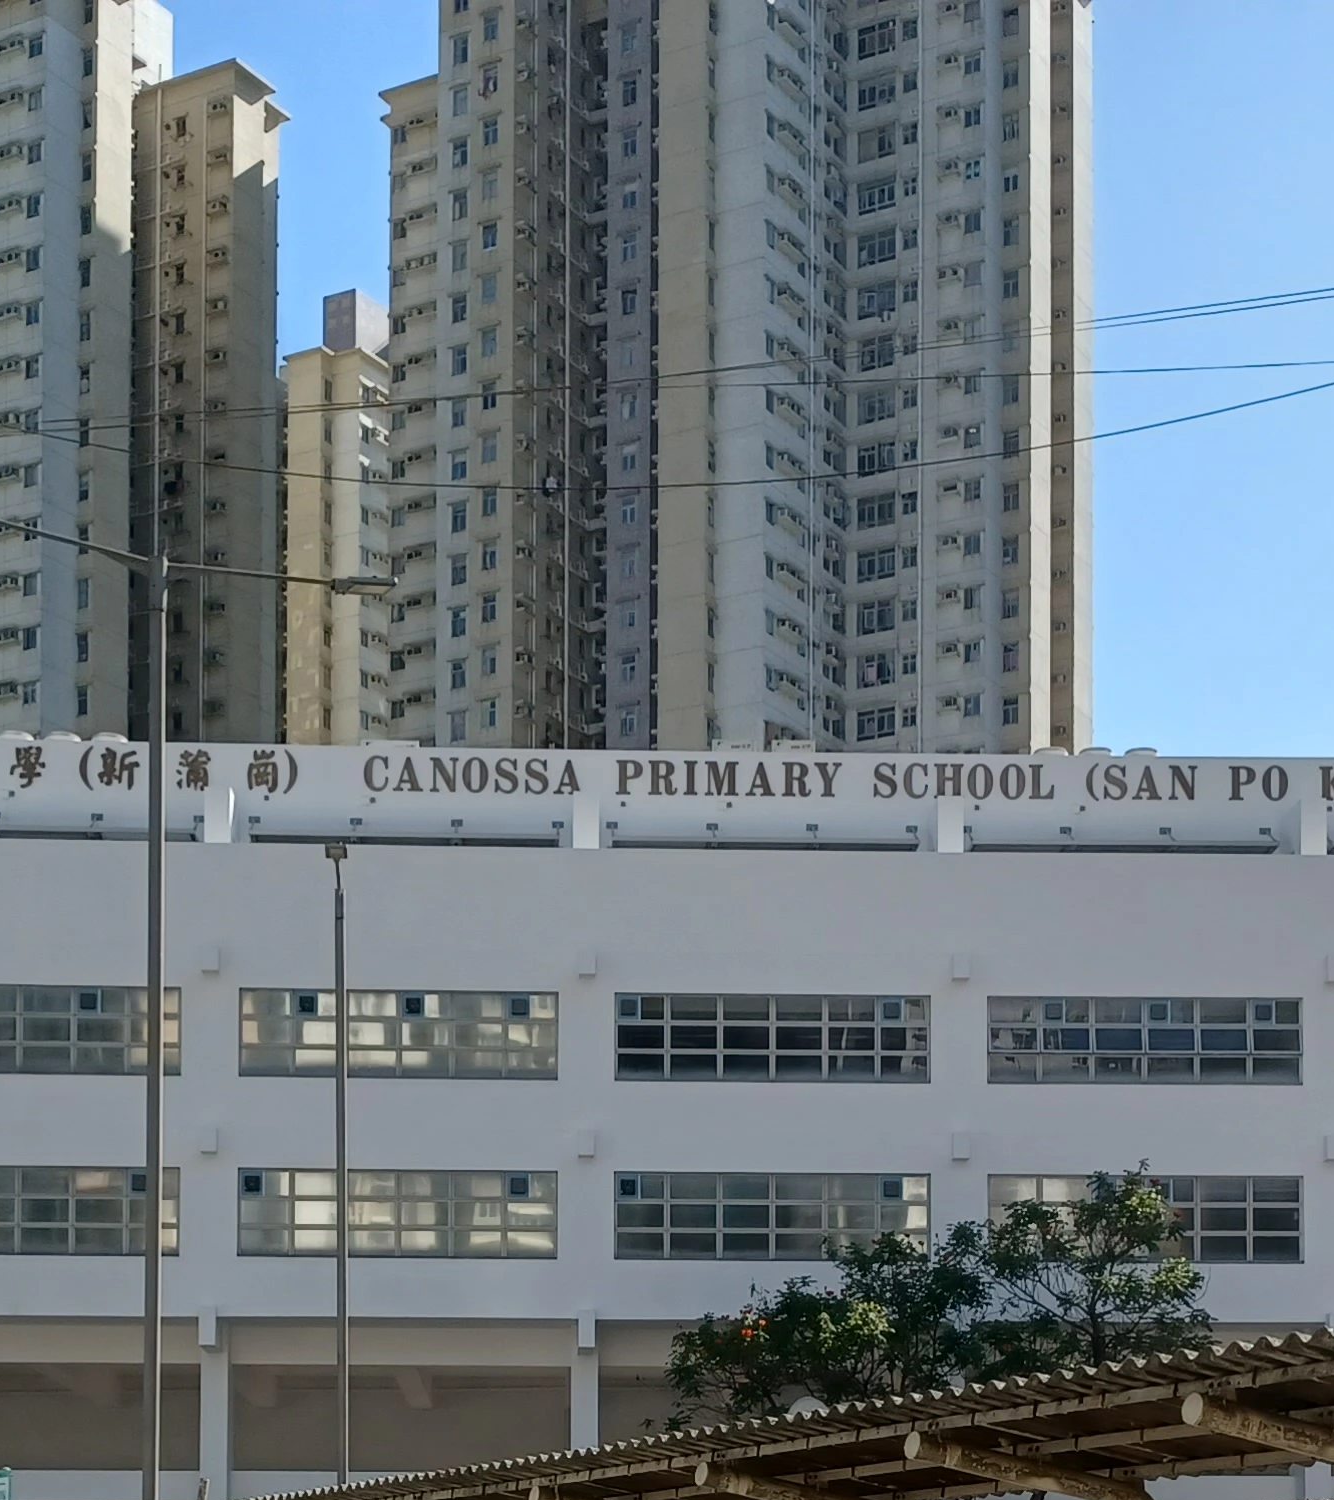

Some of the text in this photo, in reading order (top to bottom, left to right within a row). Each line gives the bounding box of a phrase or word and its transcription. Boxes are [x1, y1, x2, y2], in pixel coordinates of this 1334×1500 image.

[364, 755, 581, 795] CANOSSA
[616, 759, 842, 799] PRIMARY
[872, 762, 1055, 800] SCHOOL
[1085, 763, 1198, 801] (SAN
[1229, 765, 1289, 801] PO
